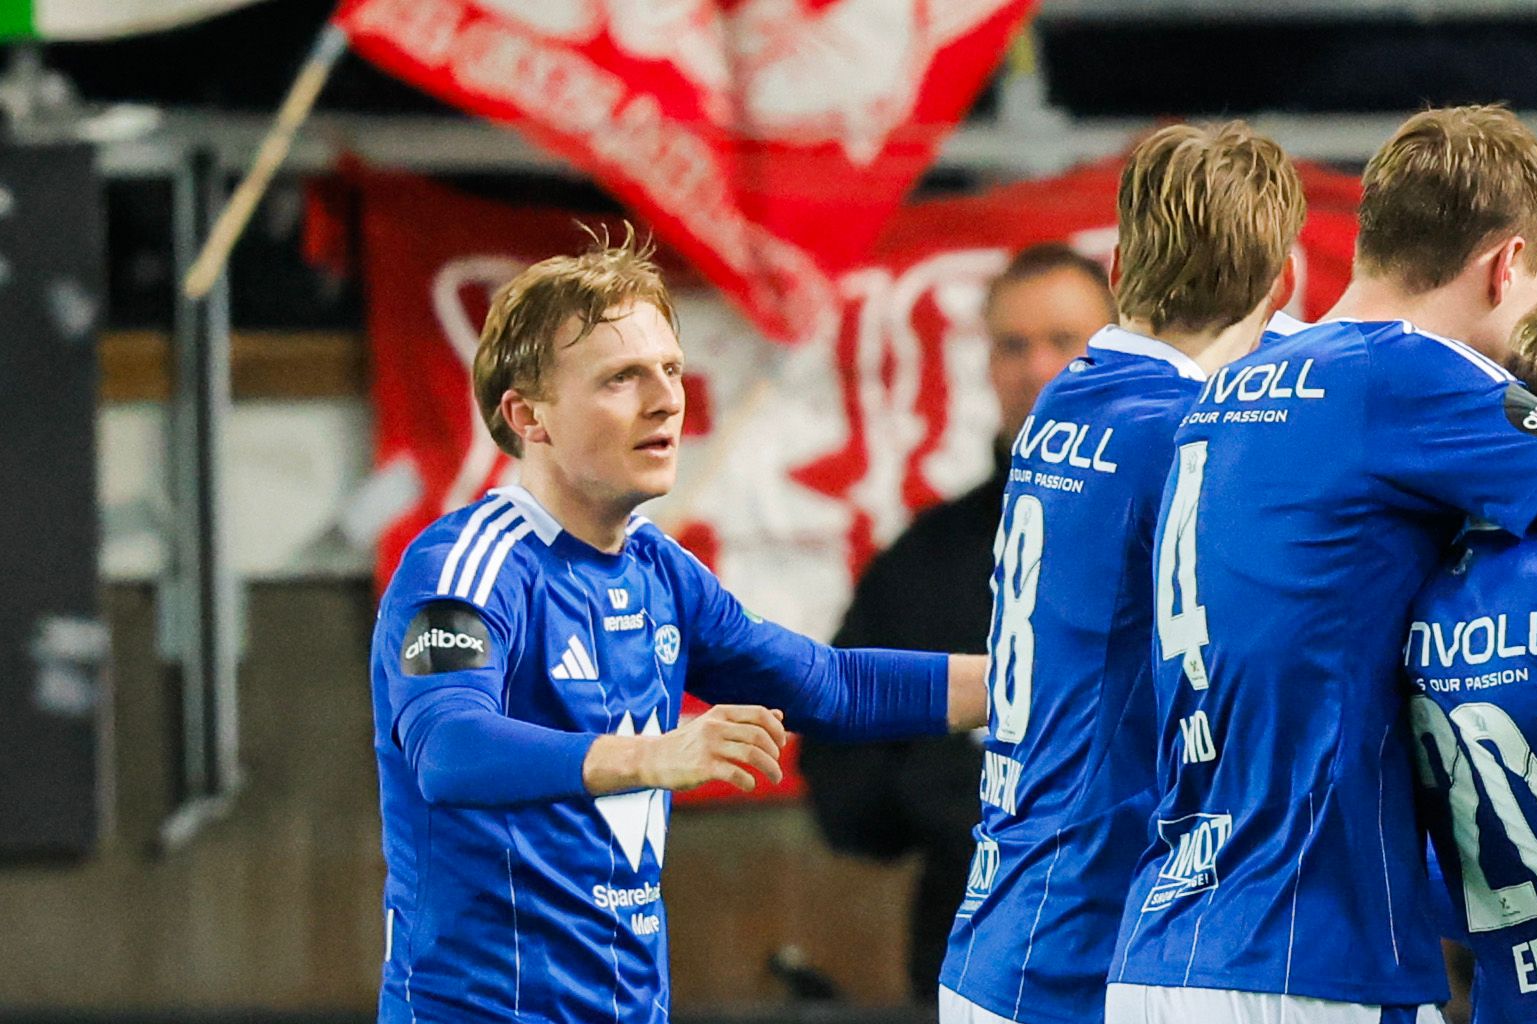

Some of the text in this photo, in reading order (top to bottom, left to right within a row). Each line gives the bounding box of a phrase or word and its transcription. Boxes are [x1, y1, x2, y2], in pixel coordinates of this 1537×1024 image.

[1189, 411, 1220, 424] OUR
[1222, 409, 1289, 424] PASSION
[1034, 472, 1085, 494] PASSION
[1156, 440, 1210, 691] 4
[405, 627, 484, 660] altibox
[1429, 678, 1461, 692] OUR
[1465, 667, 1529, 691] PASSION
[1168, 816, 1231, 878] MOT
